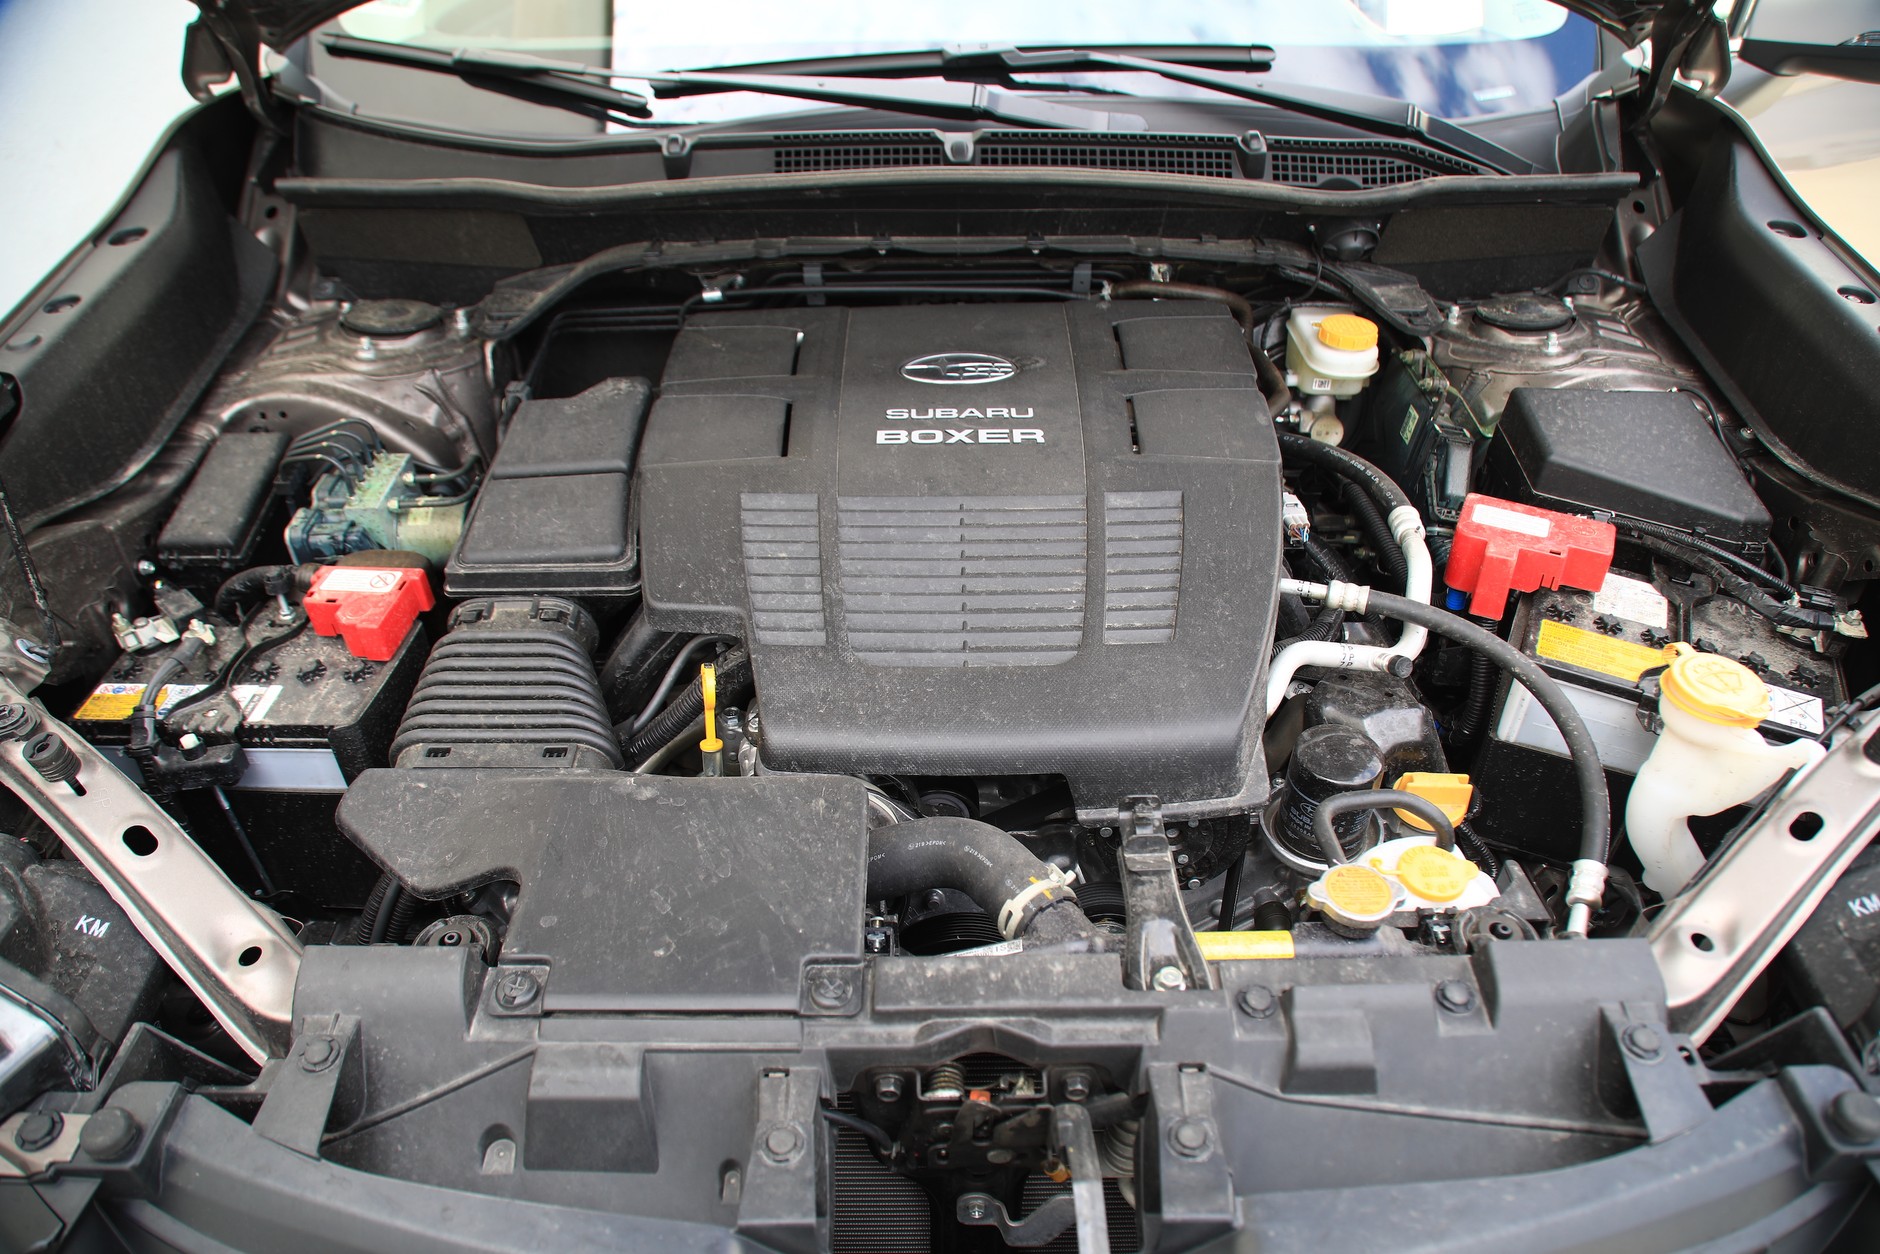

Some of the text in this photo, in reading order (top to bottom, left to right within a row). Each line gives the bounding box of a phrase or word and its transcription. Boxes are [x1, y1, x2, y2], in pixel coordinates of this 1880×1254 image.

[886, 407, 1034, 420] SUBARU
[876, 428, 1046, 444] BOXER
[74, 914, 110, 938] KM
